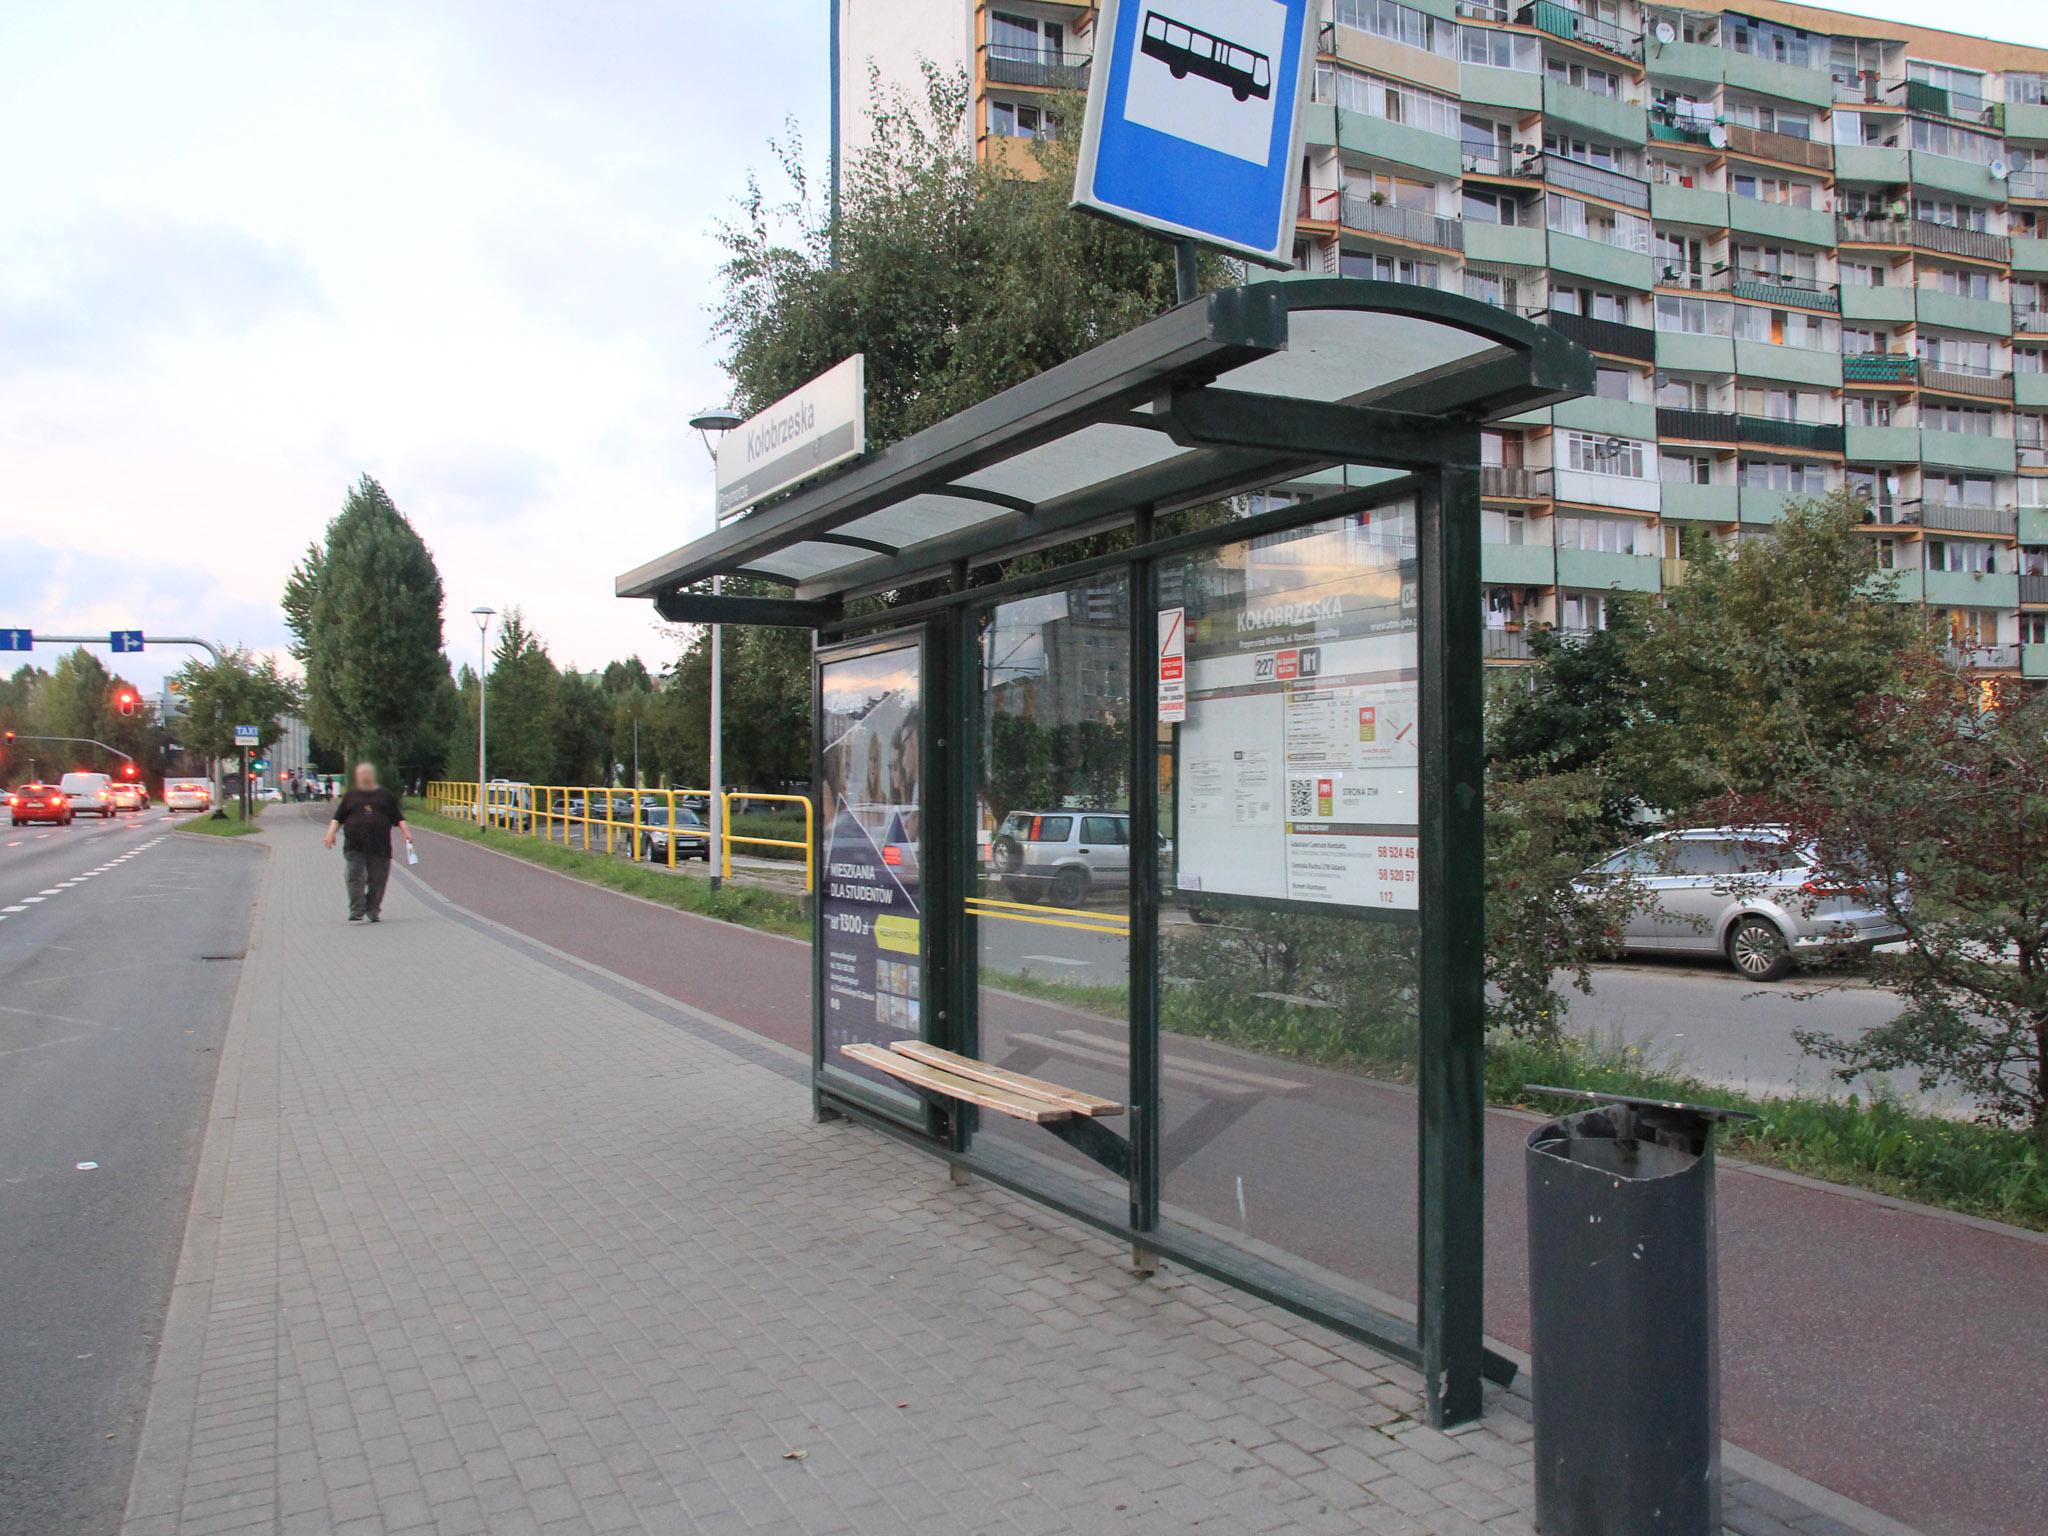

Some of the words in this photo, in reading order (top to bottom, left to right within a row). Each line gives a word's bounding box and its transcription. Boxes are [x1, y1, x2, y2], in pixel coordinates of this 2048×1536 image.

[746, 400, 815, 462] Kołobrzeska
[1237, 596, 1343, 632] KOŁOBRZESKA
[1256, 658, 1274, 677] 227
[1303, 653, 1317, 672] N1
[235, 725, 258, 736] TAXI
[1378, 846, 1388, 858] 58
[1389, 846, 1403, 859] 524
[1405, 847, 1415, 859] 45
[830, 863, 876, 880] MIESZKANIA
[1378, 868, 1388, 880] 58
[1390, 869, 1404, 881] 520
[1406, 870, 1415, 882] 57
[830, 883, 846, 898] DLA
[846, 884, 893, 905] STUDENTÓW
[1379, 891, 1394, 903] 112
[839, 913, 862, 934] 1300
